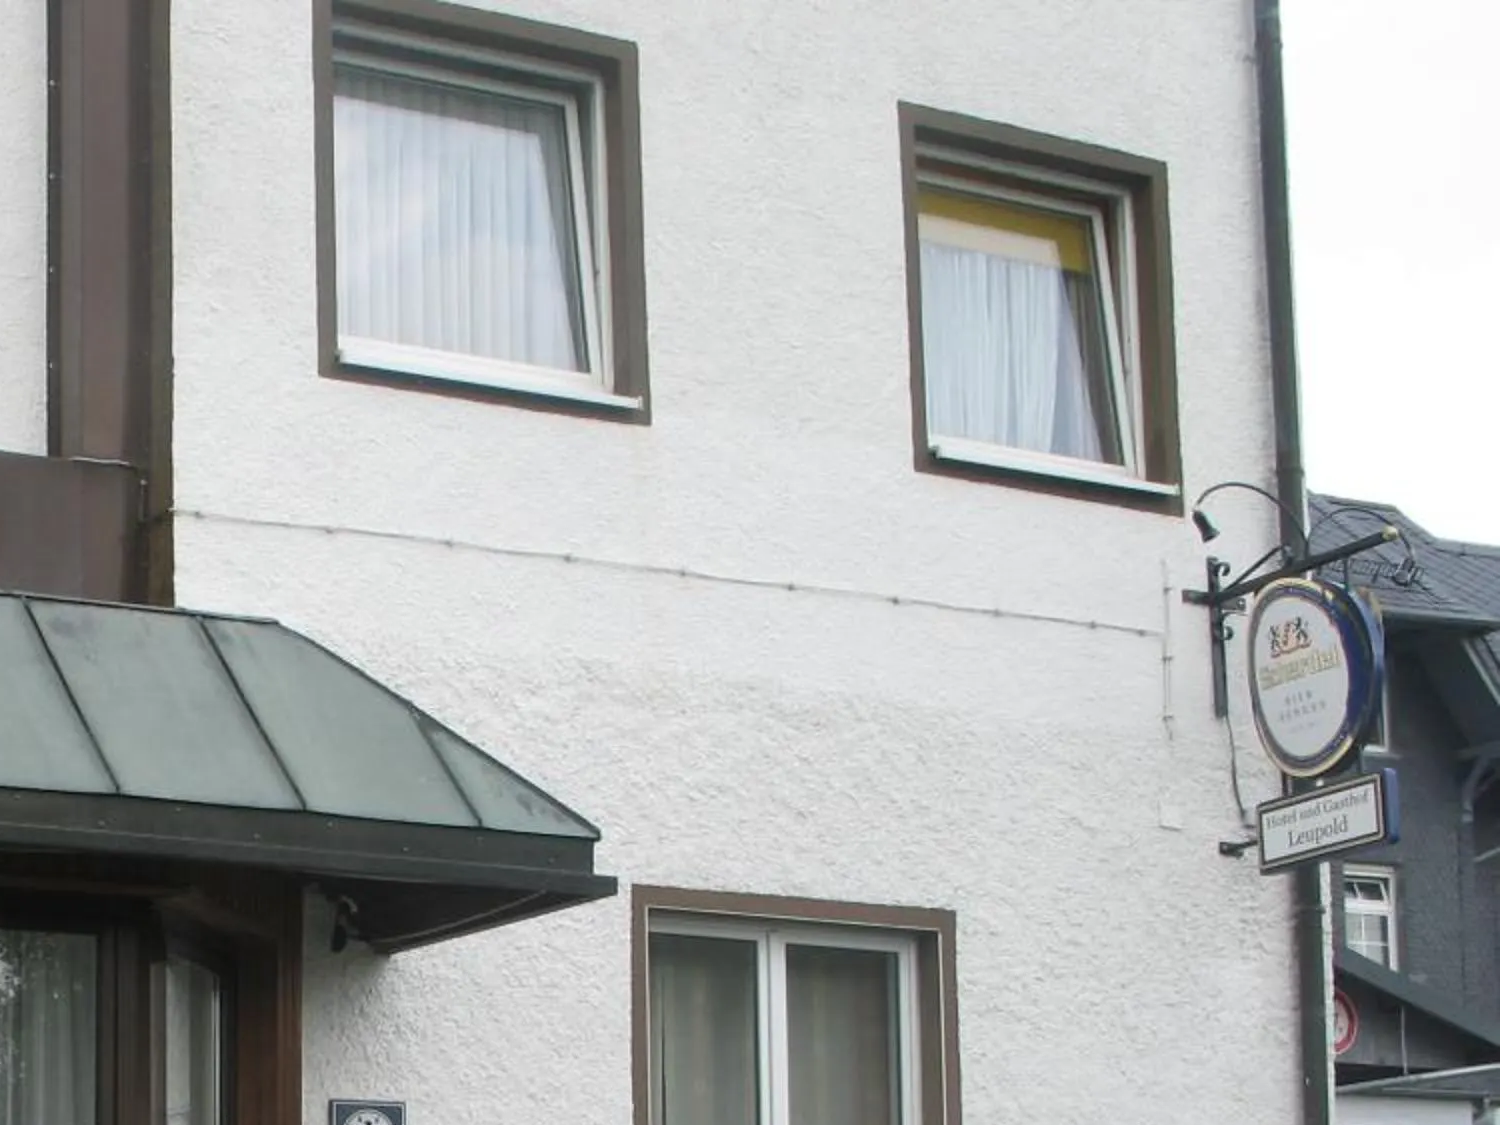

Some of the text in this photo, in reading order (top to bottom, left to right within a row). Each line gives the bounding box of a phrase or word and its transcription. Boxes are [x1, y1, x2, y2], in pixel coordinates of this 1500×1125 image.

[1265, 788, 1369, 829] Hotel und Gasthof
[1288, 814, 1348, 847] Leupold
